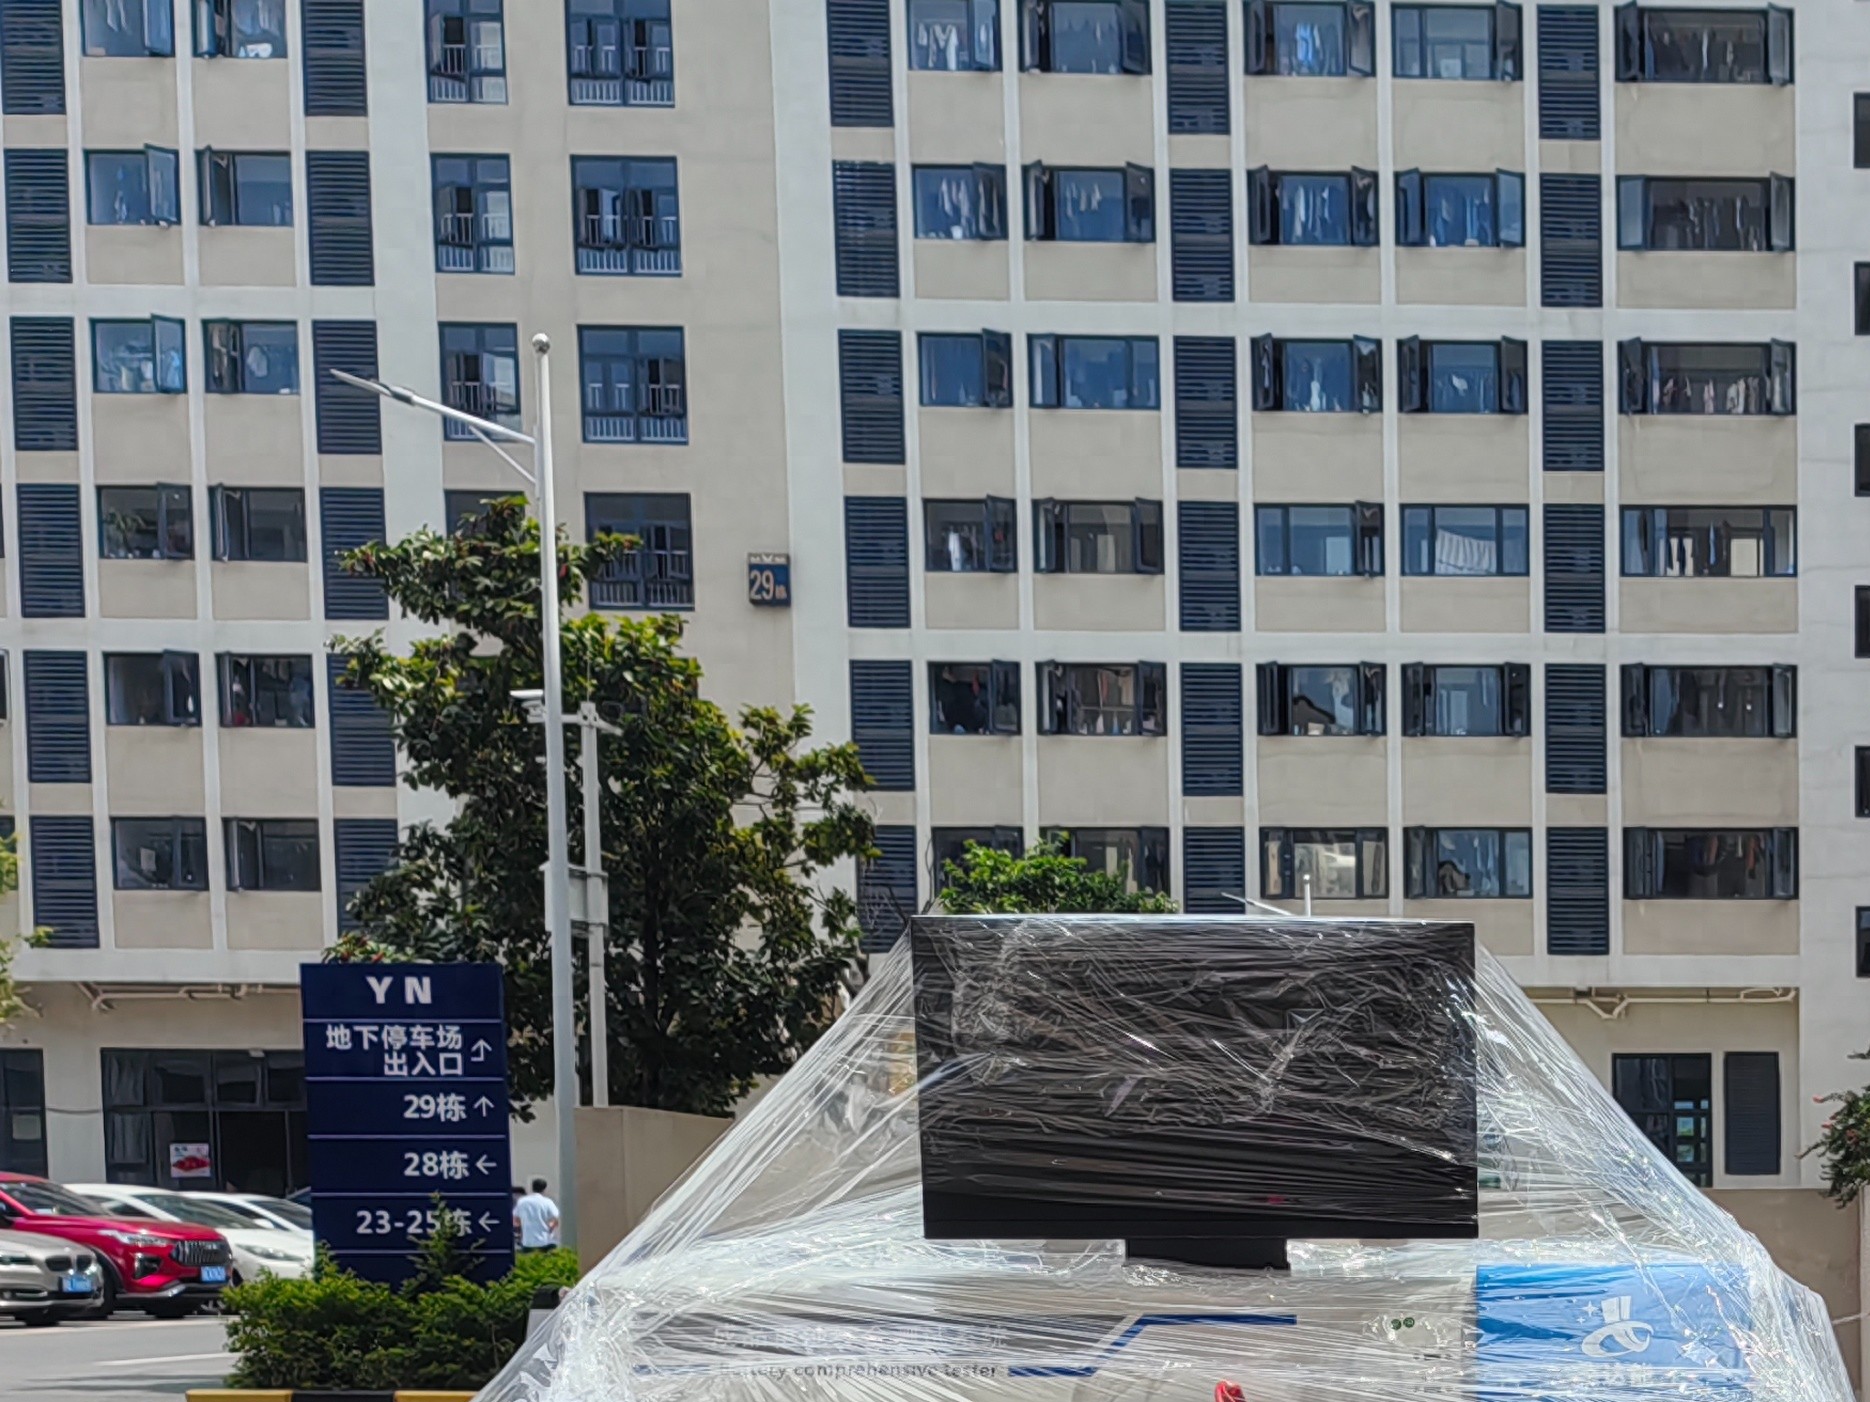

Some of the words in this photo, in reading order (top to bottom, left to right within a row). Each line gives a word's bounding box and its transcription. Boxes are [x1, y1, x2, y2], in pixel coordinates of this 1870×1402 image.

[750, 570, 787, 600] 29
[326, 1024, 462, 1050] 地下停车场
[383, 1052, 463, 1077] 出入口
[403, 1093, 467, 1122] 29栋
[403, 1151, 469, 1180] 28栋
